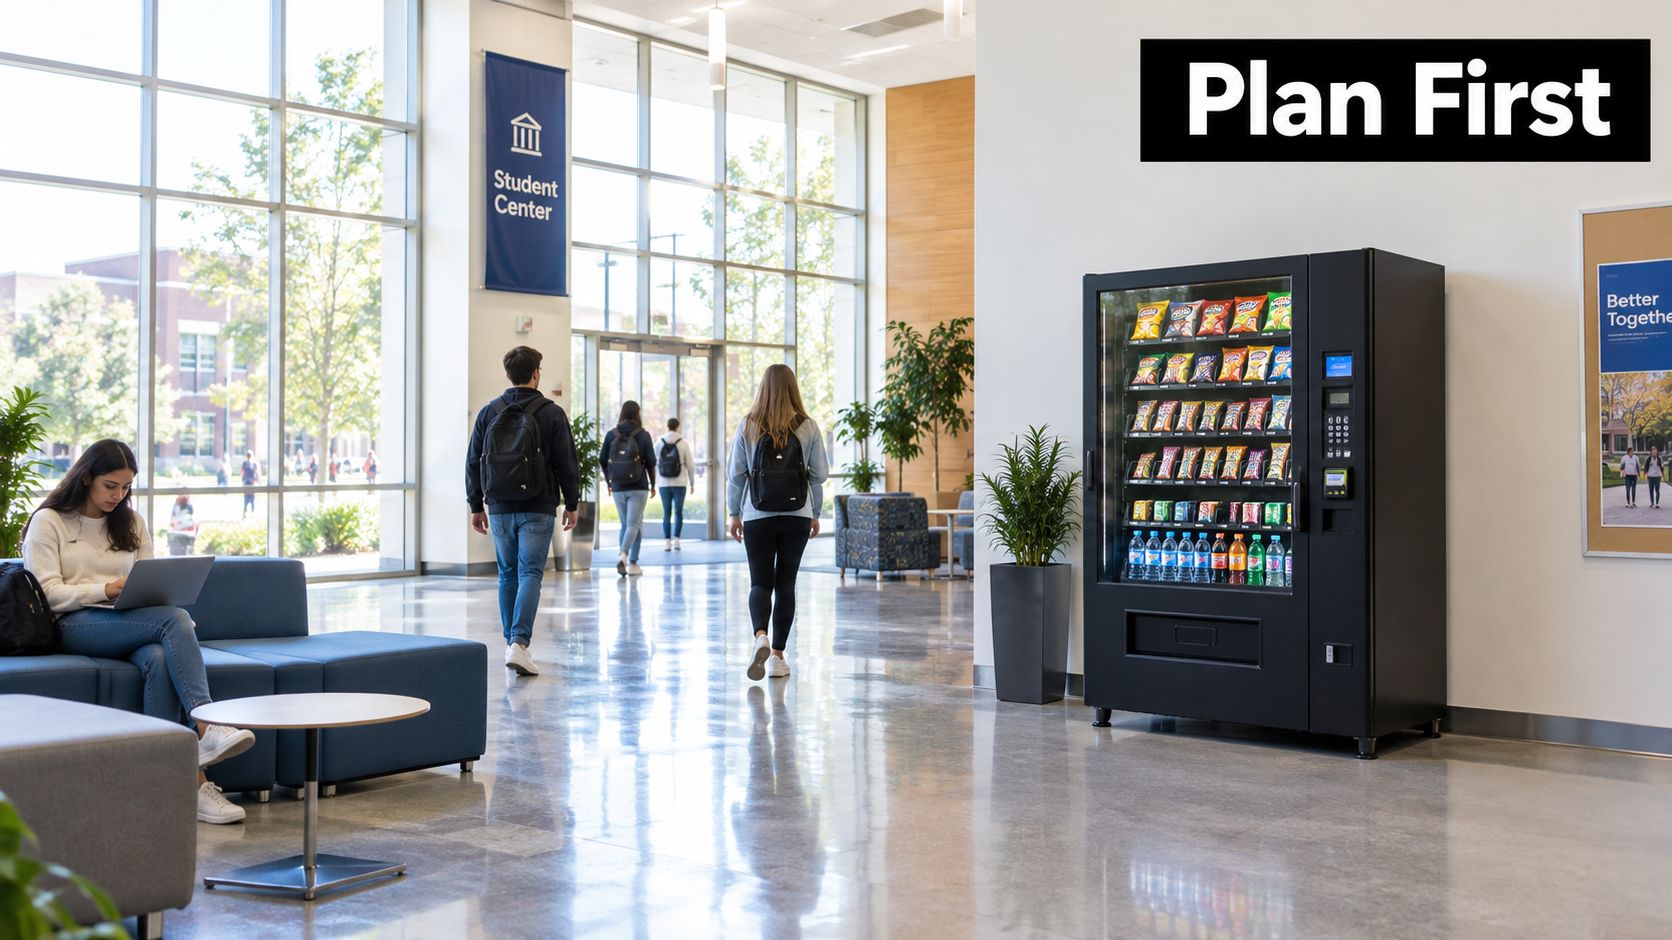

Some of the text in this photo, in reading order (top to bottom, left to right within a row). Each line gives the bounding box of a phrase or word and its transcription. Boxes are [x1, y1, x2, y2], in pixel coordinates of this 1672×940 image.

[494, 169, 559, 198] Student
[494, 193, 552, 221] Center
[1607, 293, 1659, 308] Better
